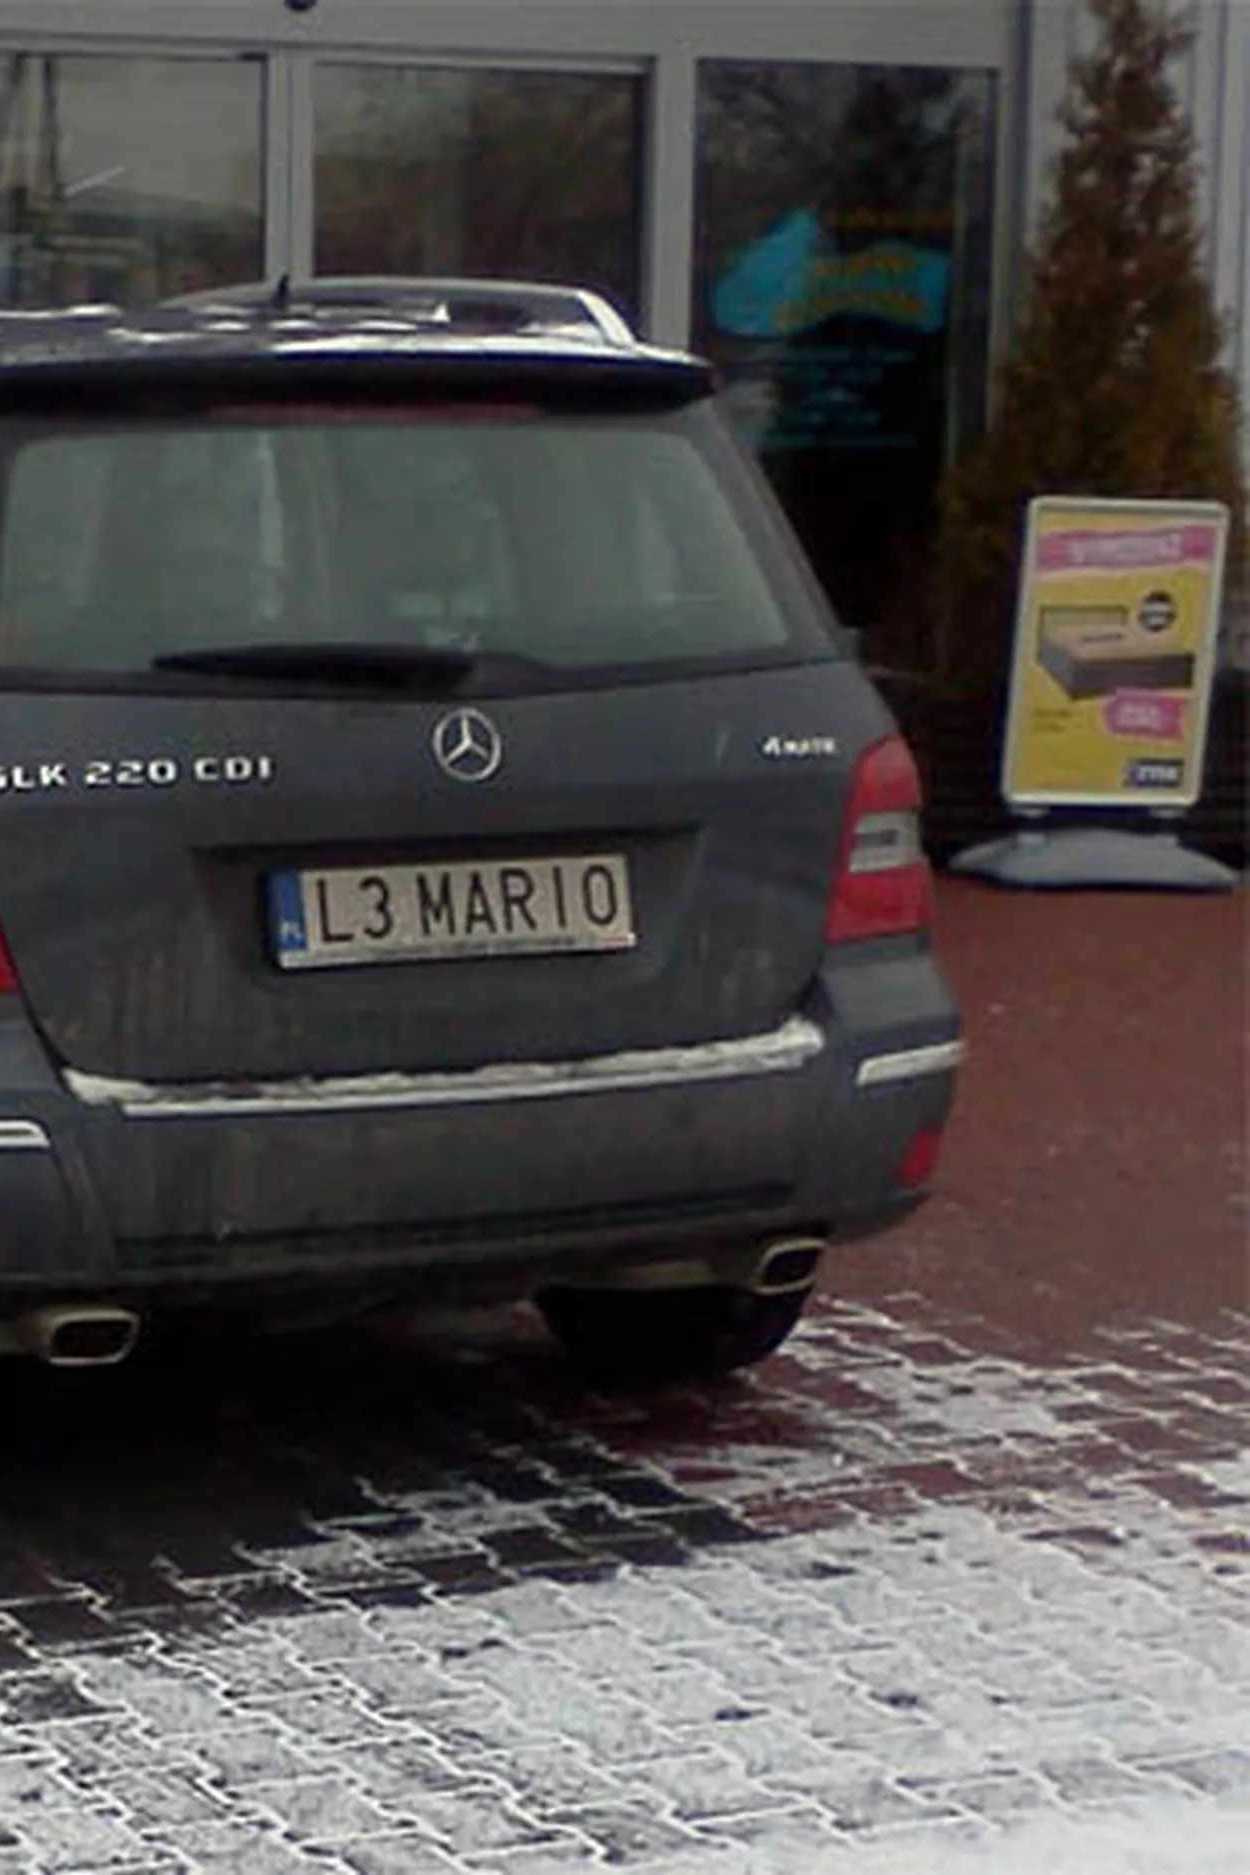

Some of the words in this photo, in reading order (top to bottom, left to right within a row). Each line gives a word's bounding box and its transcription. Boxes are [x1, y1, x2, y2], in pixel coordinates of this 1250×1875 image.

[84, 760, 177, 784] 220
[193, 757, 270, 781] CDI
[316, 876, 393, 943] L3
[416, 865, 618, 936] MARIO
